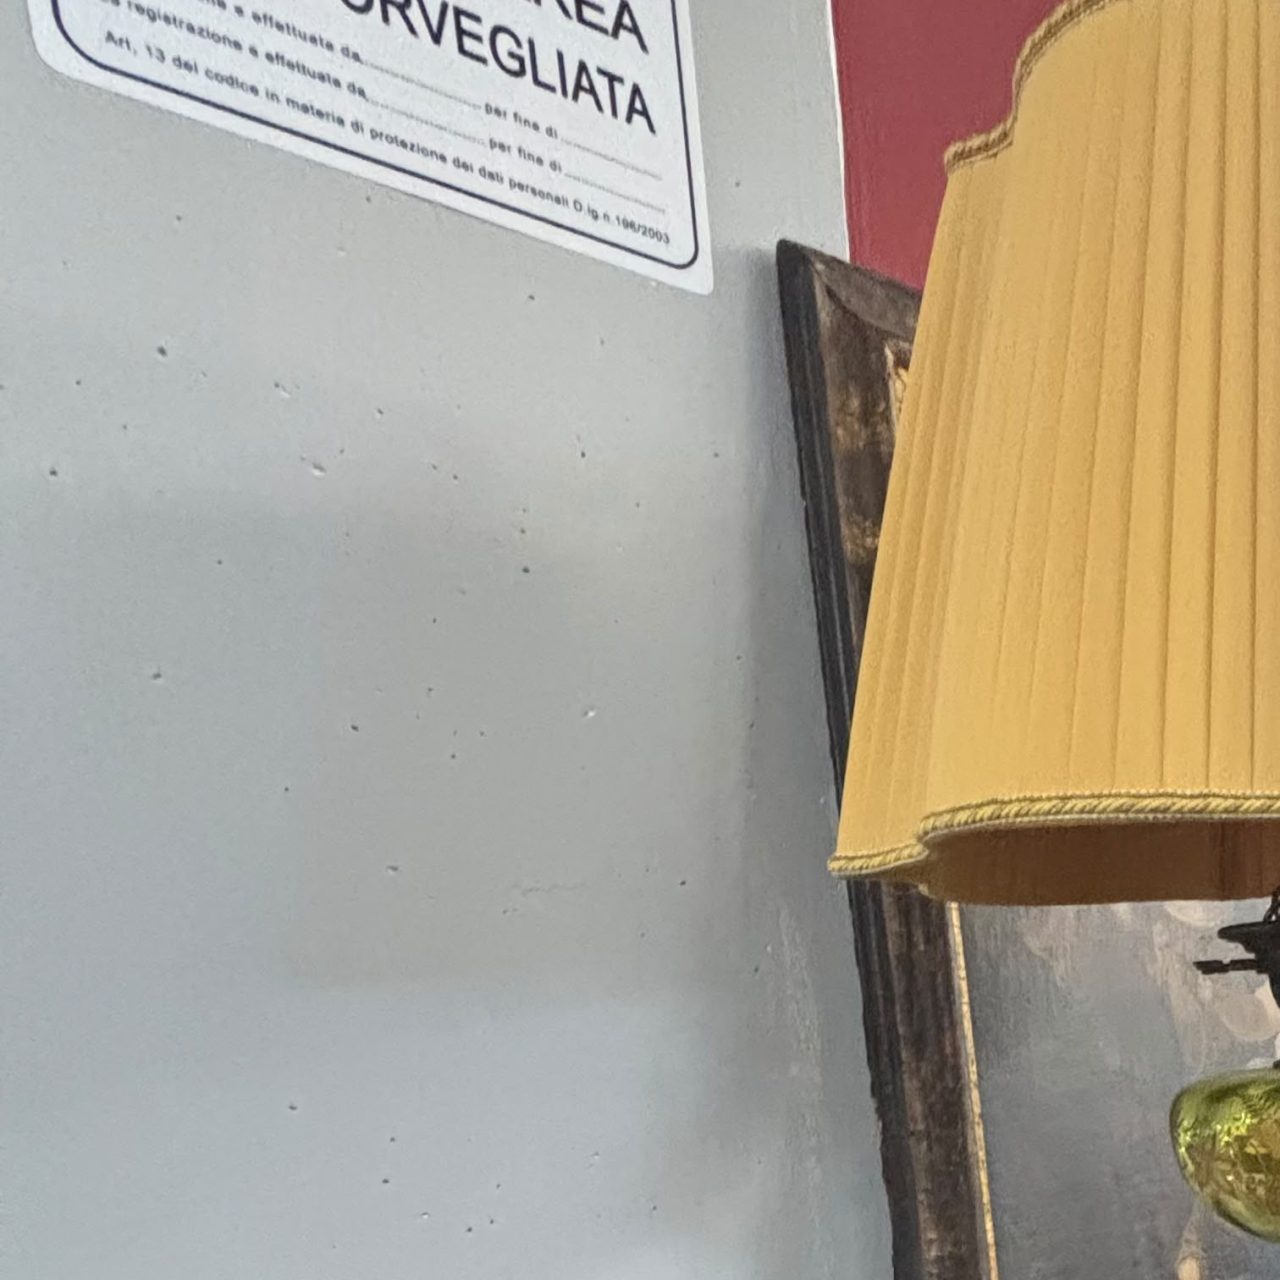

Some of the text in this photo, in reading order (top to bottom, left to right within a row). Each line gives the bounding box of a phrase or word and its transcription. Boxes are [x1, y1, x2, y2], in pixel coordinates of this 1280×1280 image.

[145, 44, 166, 64] 13
[171, 54, 199, 75] del
[205, 66, 260, 97] codice
[265, 88, 280, 105] in
[285, 97, 345, 128] materia
[350, 118, 364, 135] di
[369, 127, 448, 165] protezione
[452, 155, 474, 174] dei
[478, 165, 504, 186] dati
[508, 177, 570, 210] personali
[545, 126, 558, 140] di
[489, 137, 511, 152] per
[549, 159, 562, 174] di
